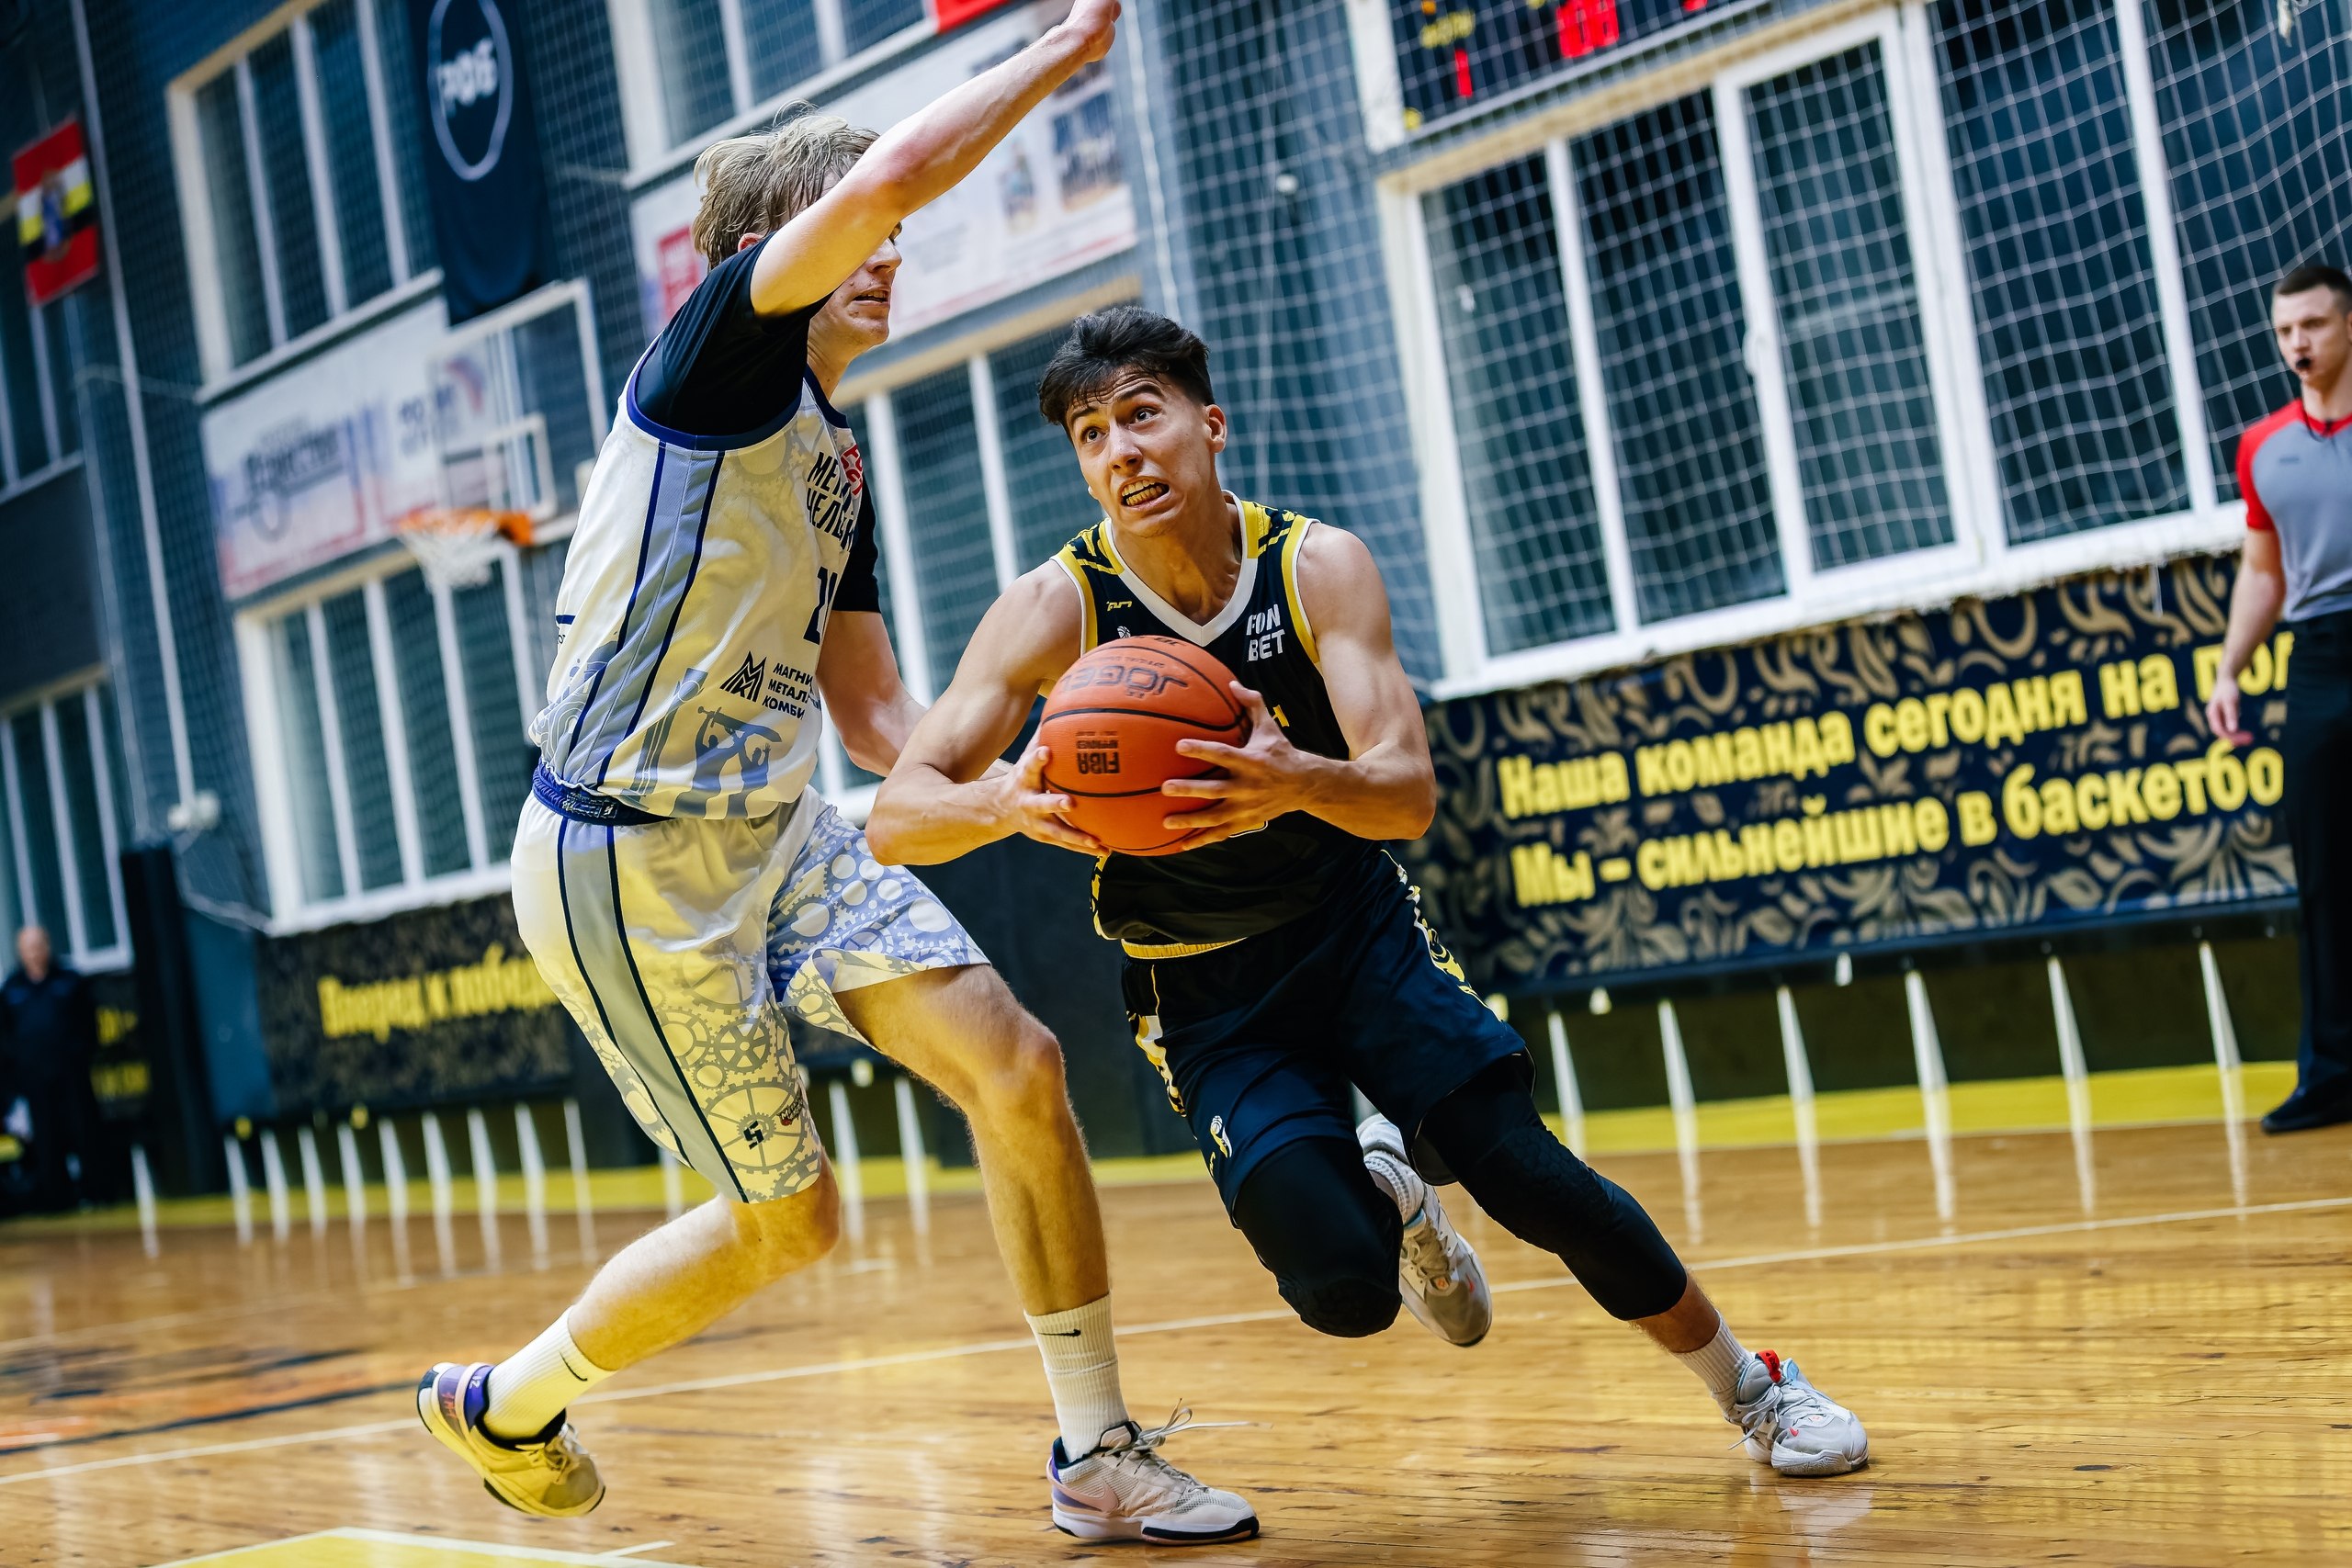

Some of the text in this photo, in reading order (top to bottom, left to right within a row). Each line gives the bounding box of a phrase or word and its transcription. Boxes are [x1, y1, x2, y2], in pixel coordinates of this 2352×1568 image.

[1246, 604, 1281, 636] FON
[1248, 628, 1285, 661] BET
[1498, 750, 1630, 819] Наша
[1634, 710, 1856, 797] команда
[1864, 669, 2087, 759] сегодня
[2098, 653, 2179, 718] на
[1077, 751, 1121, 774] FIBA
[1510, 841, 1596, 908] Мы
[1636, 793, 1949, 891] сильнейшие
[1955, 790, 1998, 848] в
[2002, 738, 2284, 840] баскетбо
